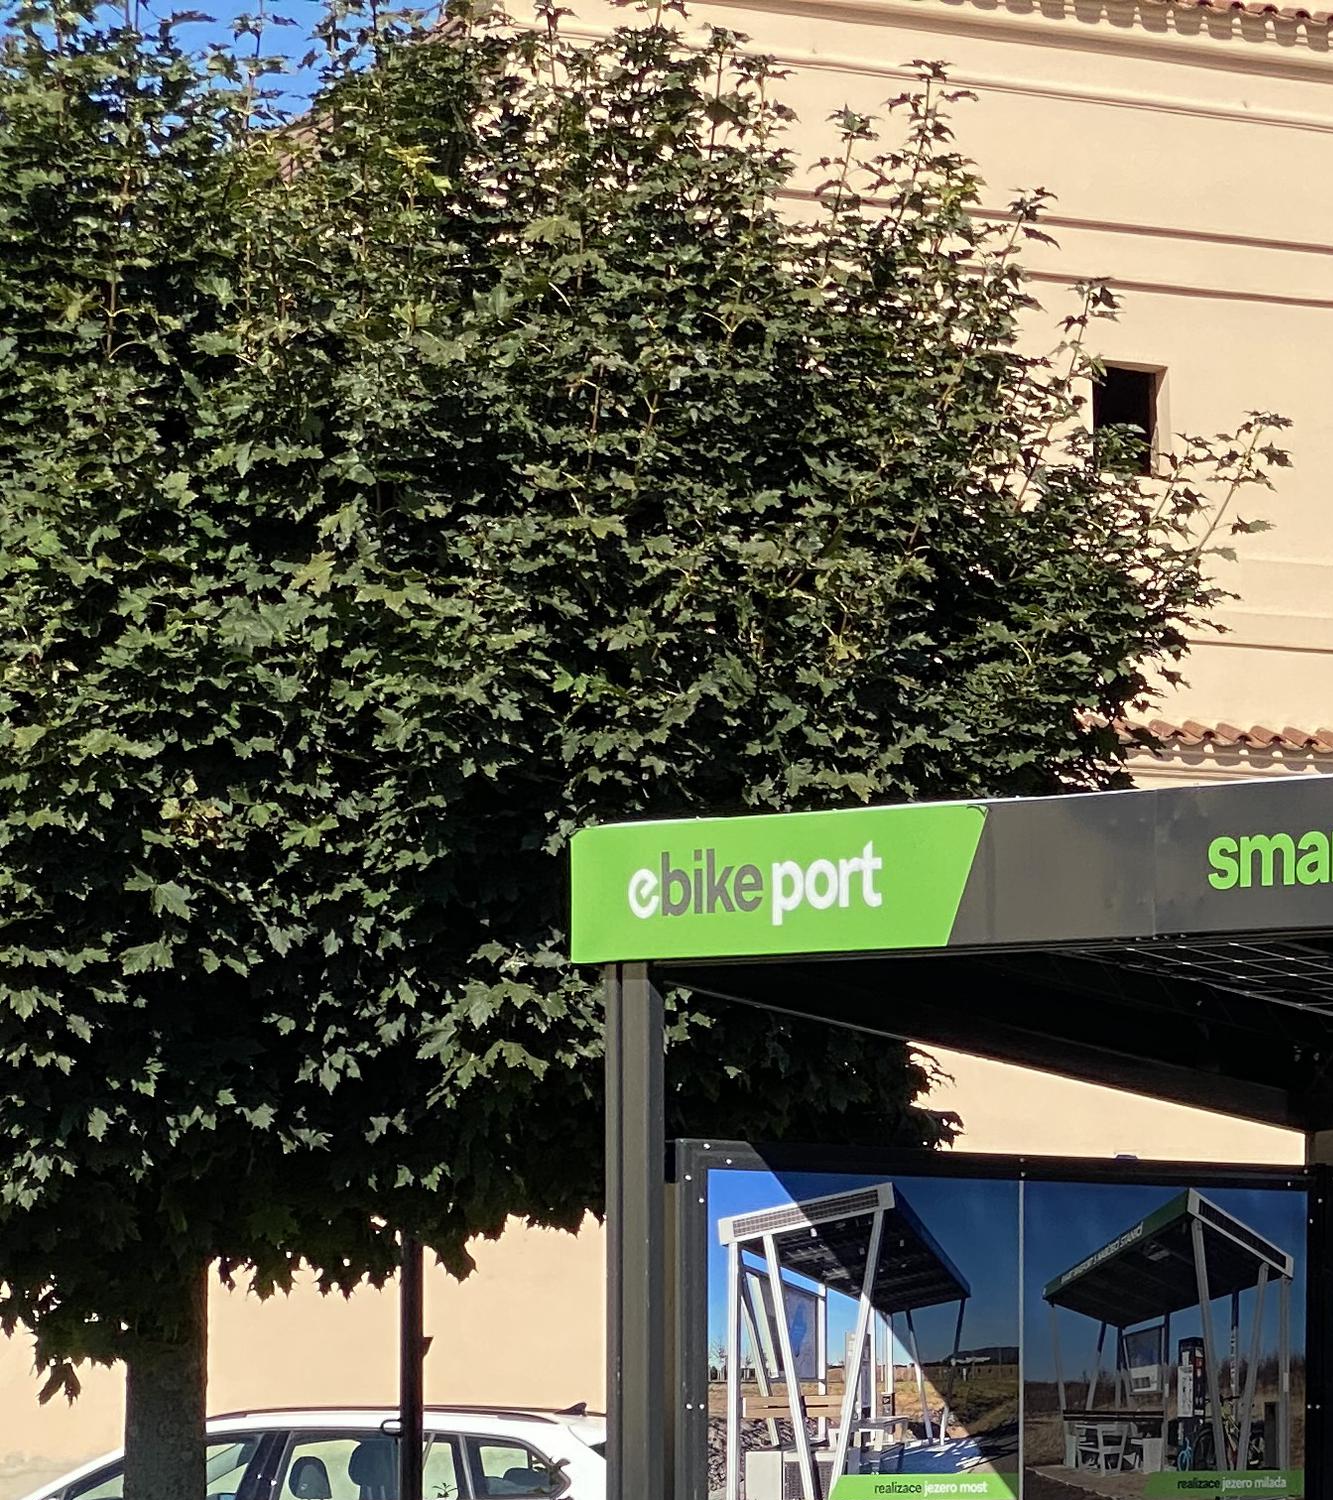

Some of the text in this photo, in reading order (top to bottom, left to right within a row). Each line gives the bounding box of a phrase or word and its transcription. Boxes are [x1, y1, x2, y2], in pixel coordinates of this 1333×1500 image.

[874, 1480, 988, 1497] realizace jezero most
[1177, 1475, 1287, 1492] realizace jezero milada
